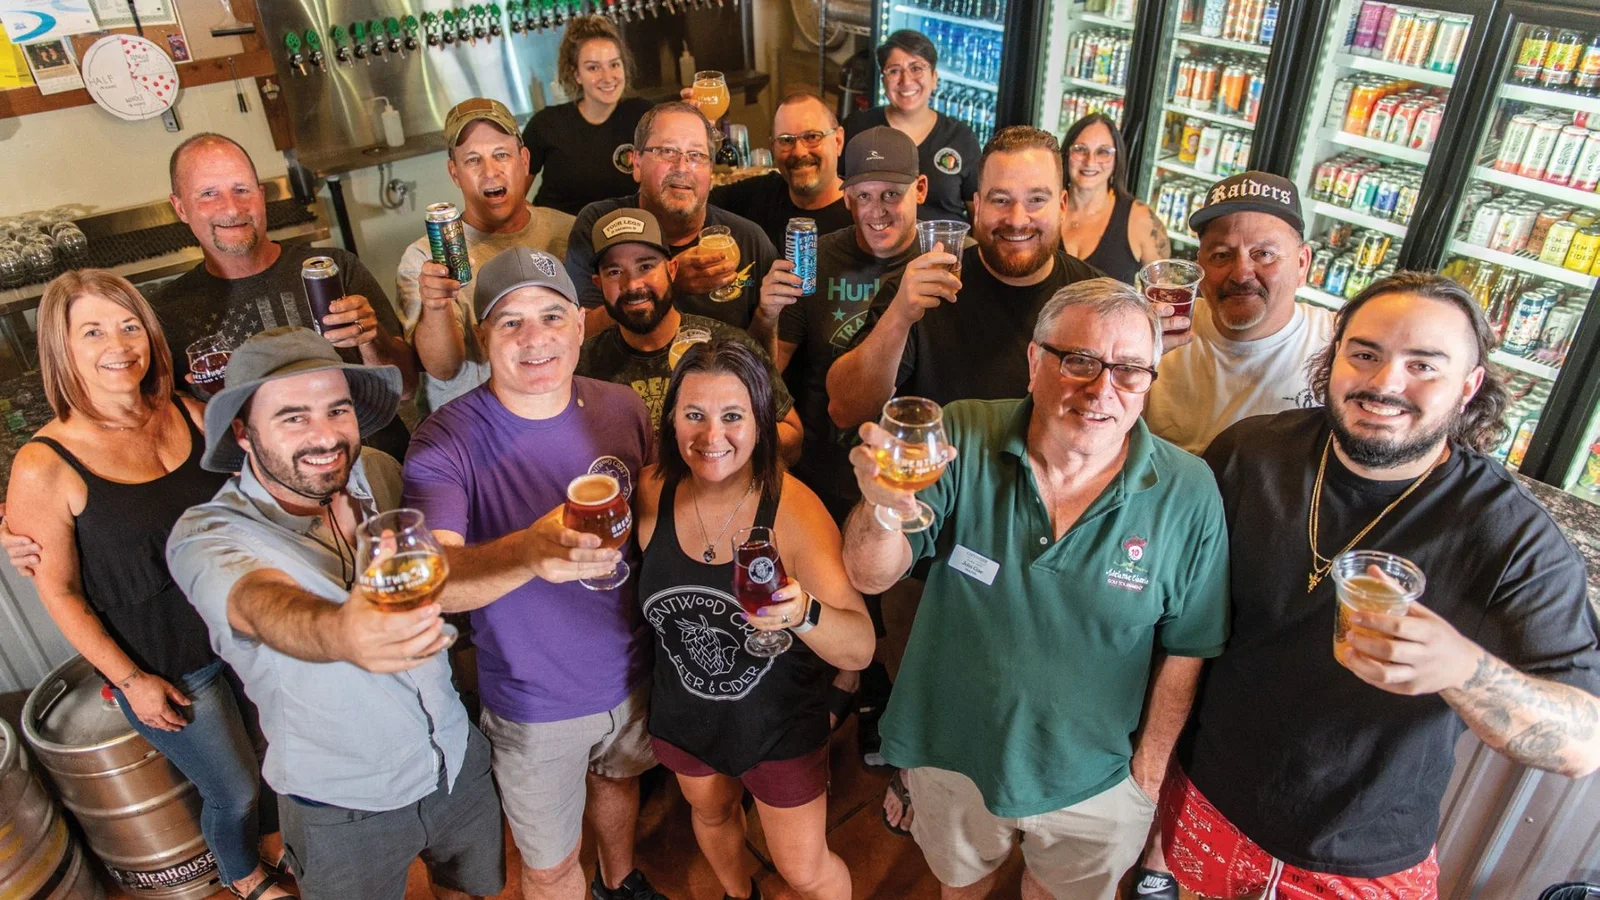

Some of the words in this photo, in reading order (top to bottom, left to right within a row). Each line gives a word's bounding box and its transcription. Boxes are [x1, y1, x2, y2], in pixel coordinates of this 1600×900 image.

[1210, 178, 1291, 205] Raiders
[606, 220, 623, 232] FOUR
[837, 316, 866, 341] TRA
[1131, 549, 1140, 557] 10
[719, 666, 760, 692] CIDER
[1143, 875, 1169, 888] NIKE
